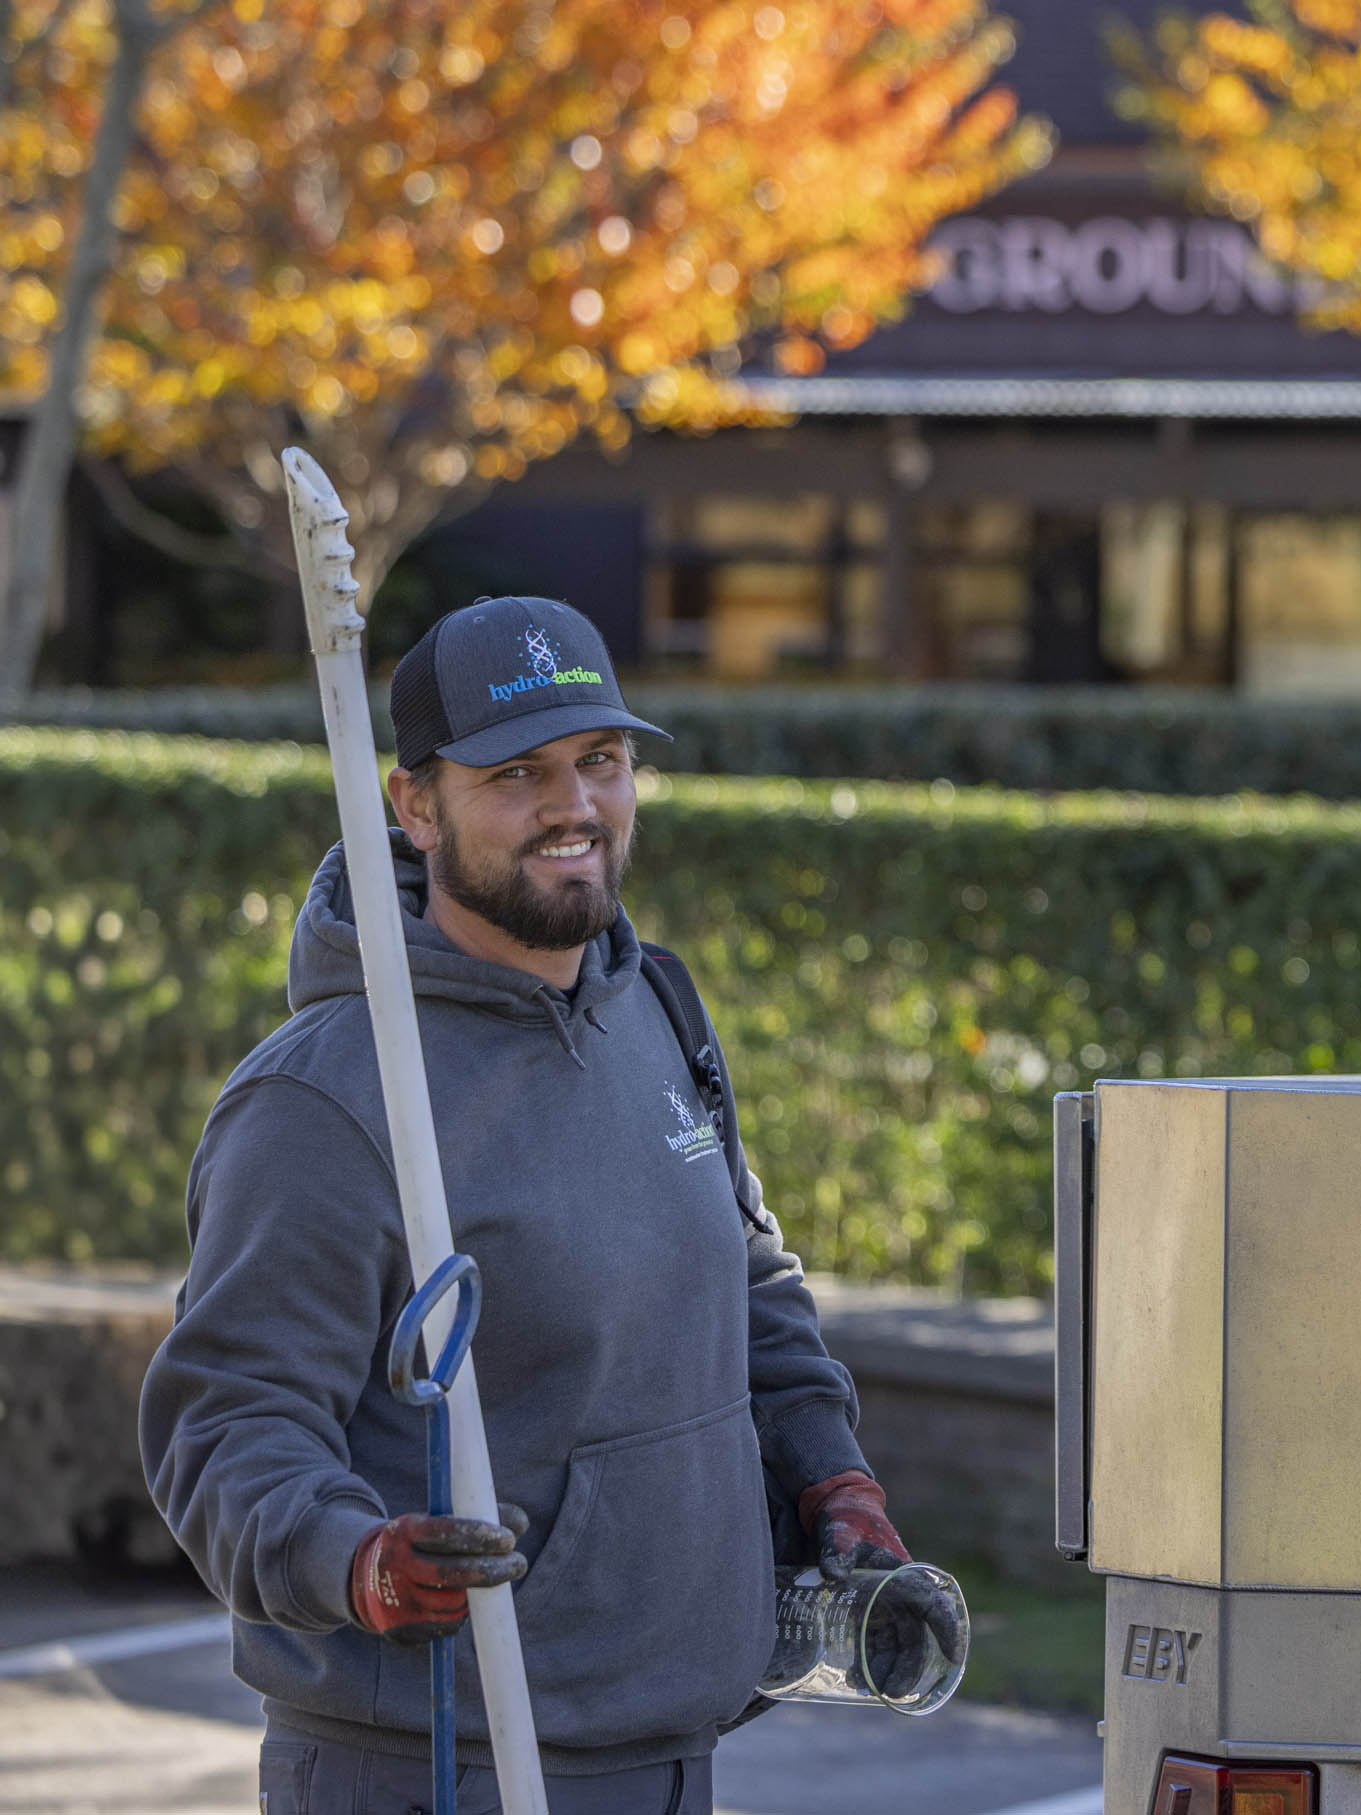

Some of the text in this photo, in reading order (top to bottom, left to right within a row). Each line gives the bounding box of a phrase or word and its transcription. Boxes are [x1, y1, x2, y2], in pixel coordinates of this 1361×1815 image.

[926, 215, 1328, 316] GROUN
[488, 666, 603, 702] hydro action
[664, 1129, 697, 1153] hydro
[1122, 1624, 1203, 1686] EBY
